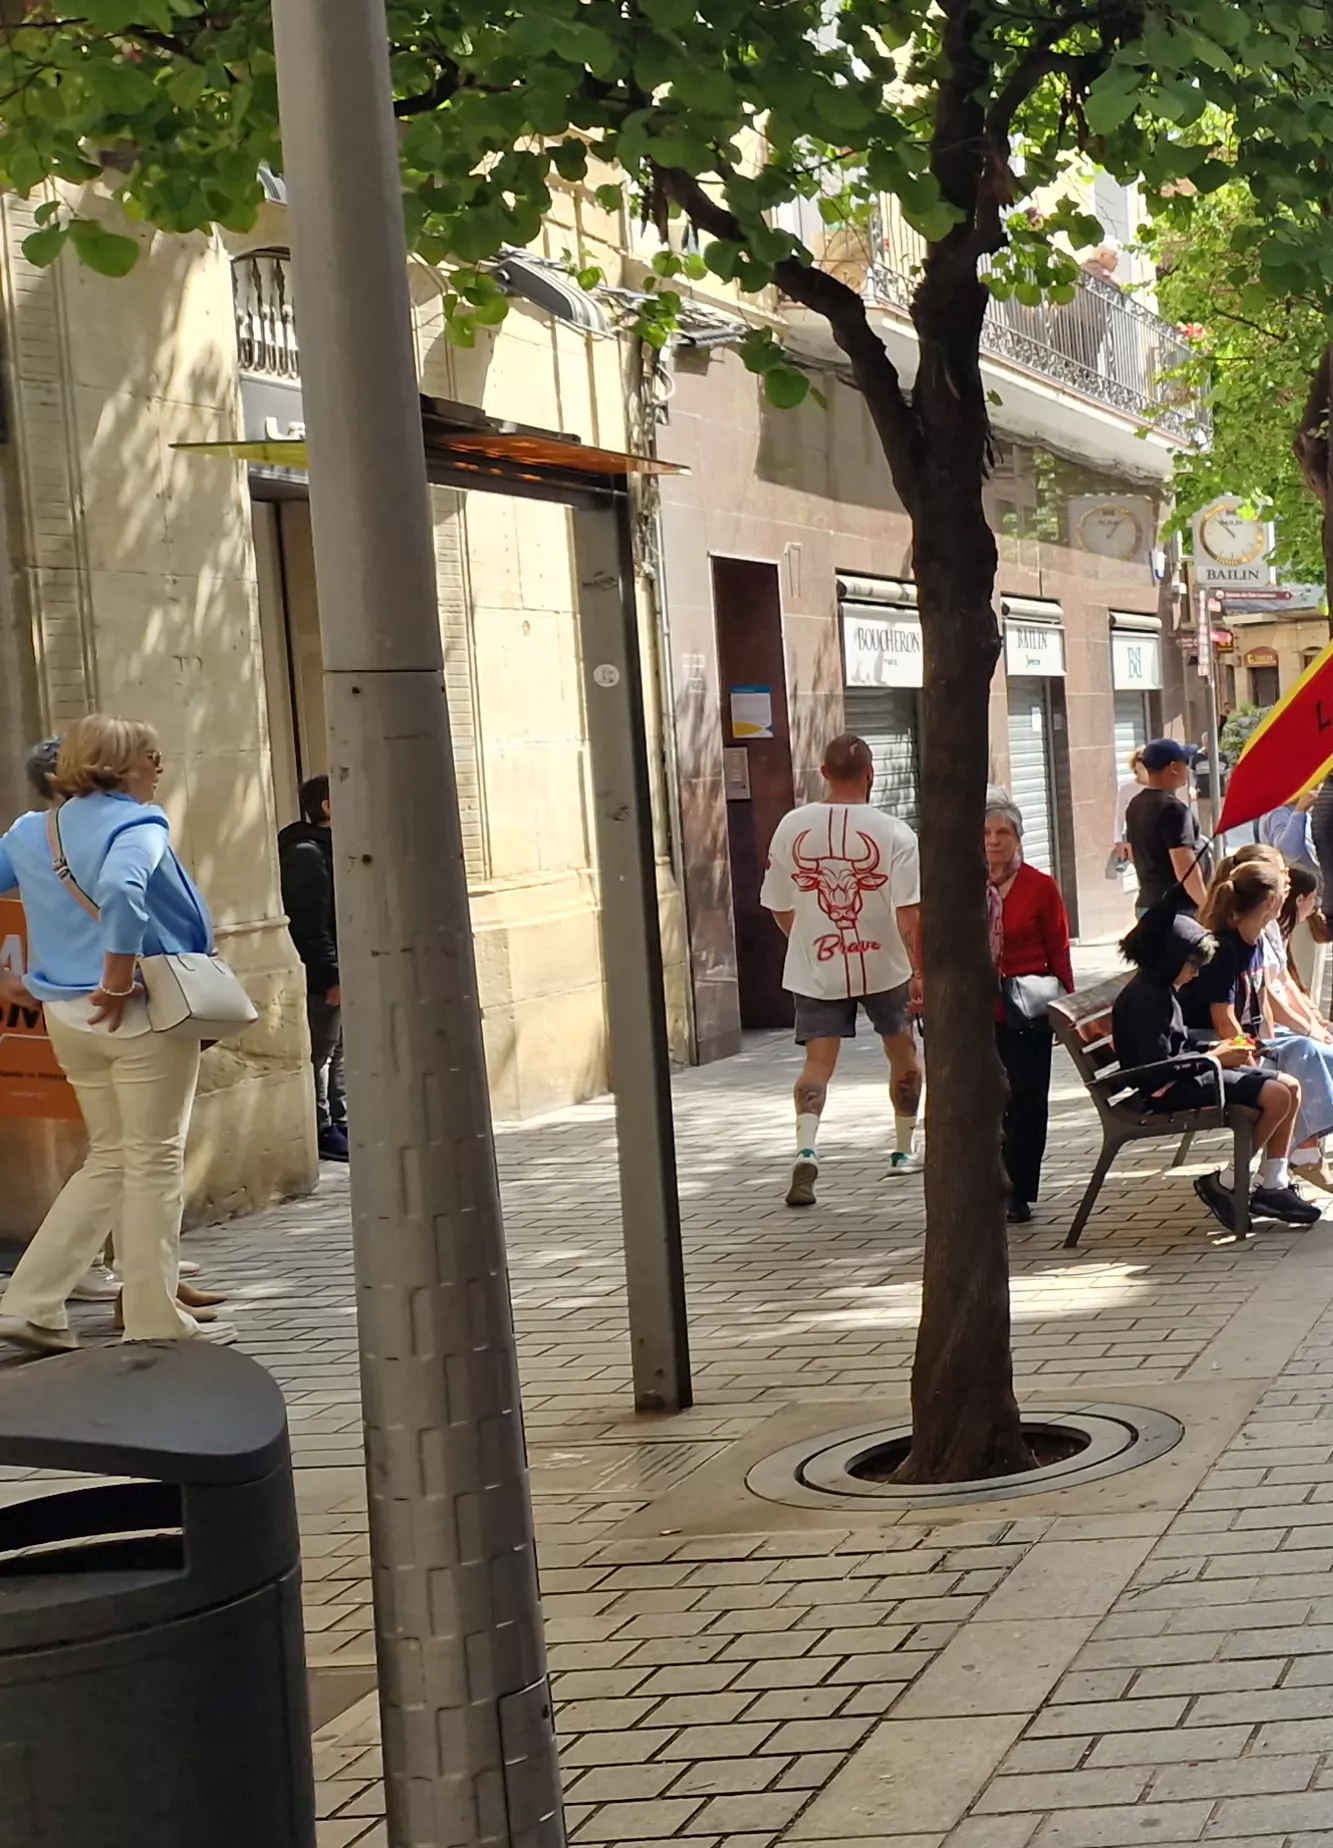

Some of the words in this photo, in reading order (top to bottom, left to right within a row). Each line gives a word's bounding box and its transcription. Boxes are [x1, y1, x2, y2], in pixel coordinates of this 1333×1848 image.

[1206, 569, 1260, 580] BAILIN
[857, 628, 920, 654] BOUCHERON
[1017, 628, 1048, 650] BAILIN
